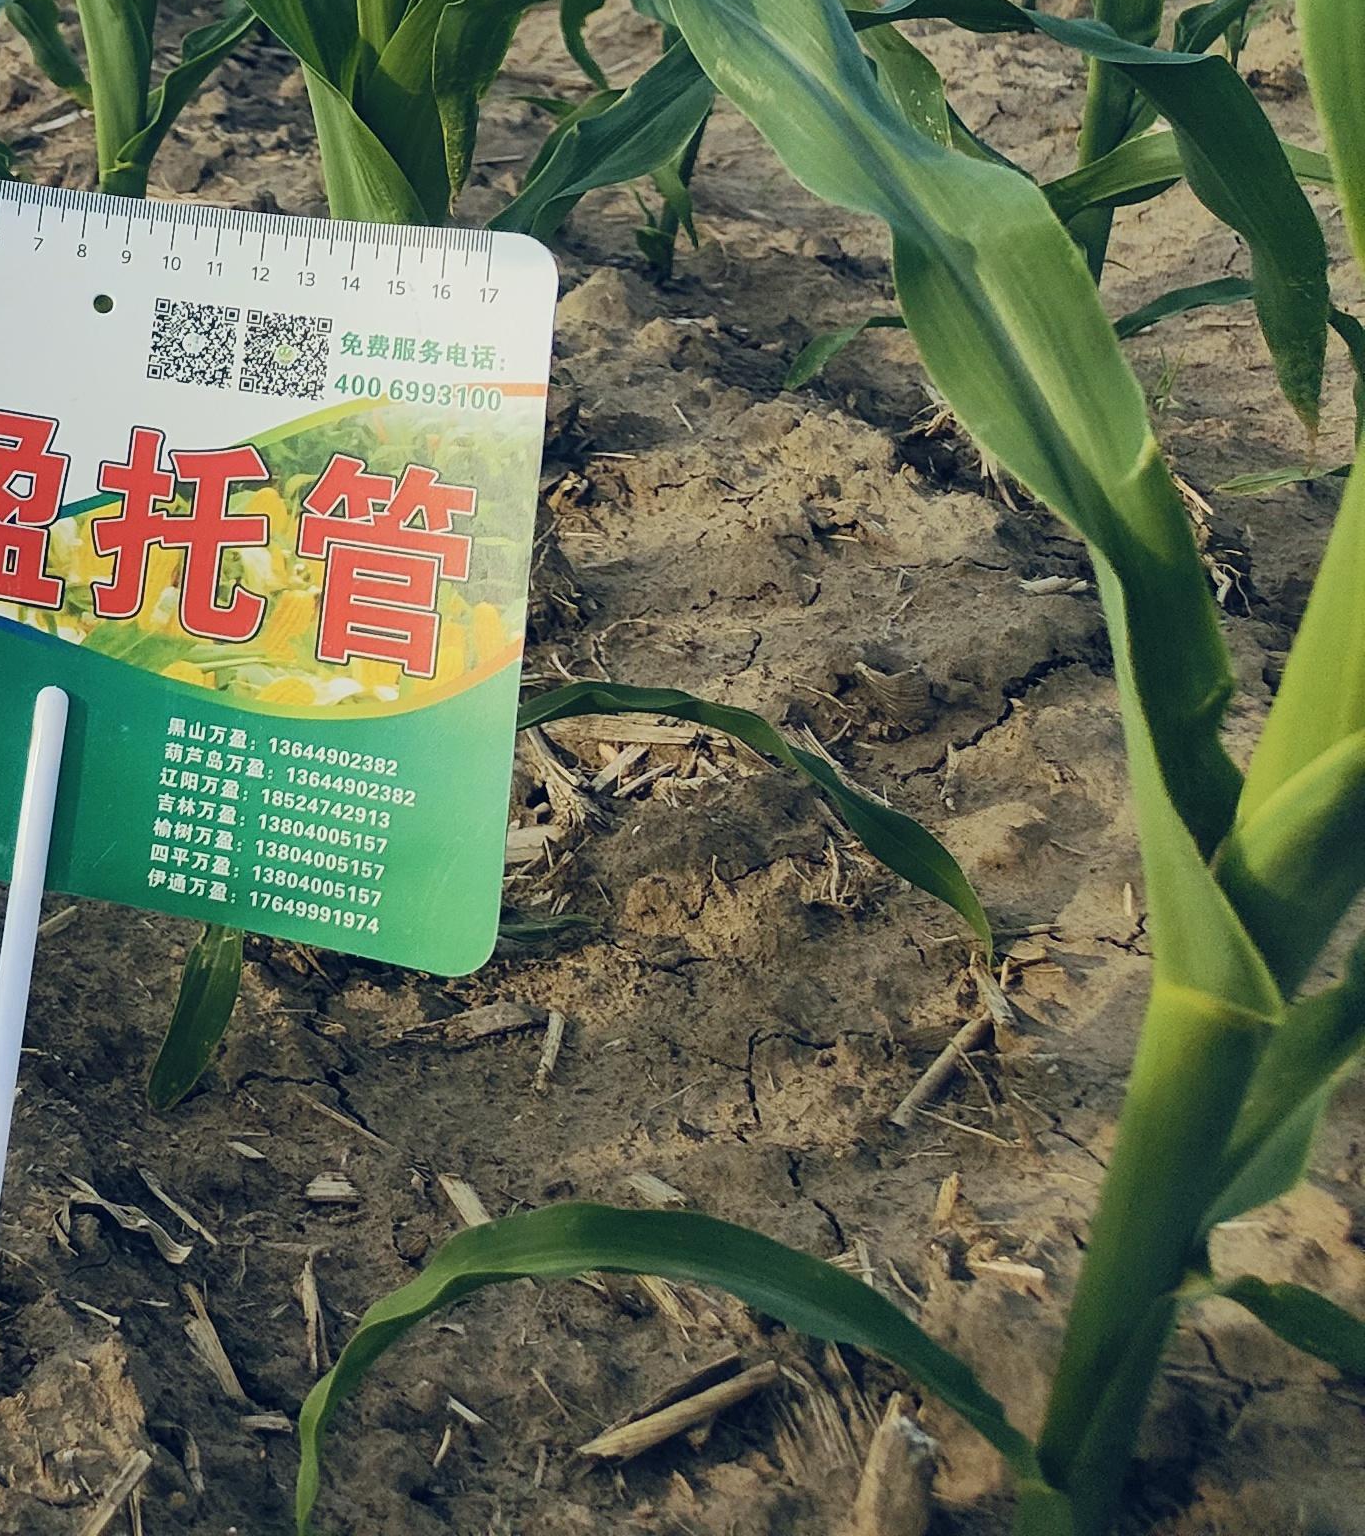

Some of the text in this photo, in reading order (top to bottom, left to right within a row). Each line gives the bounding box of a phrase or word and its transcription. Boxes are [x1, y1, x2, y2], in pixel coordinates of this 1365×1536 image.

[33, 237, 44, 251] 7
[77, 244, 87, 258] 8
[121, 250, 132, 264] 9
[162, 256, 181, 271] 10
[207, 262, 223, 276] 11
[252, 266, 270, 282] 12
[297, 272, 316, 287] 13
[342, 276, 361, 291] 14
[388, 280, 406, 296] 15
[432, 285, 451, 300] 16
[480, 288, 499, 304] 17
[334, 373, 502, 411] 400 6993100
[269, 737, 398, 777] 13644902382
[286, 767, 417, 807] 13644902382
[261, 788, 391, 829] 18524742913
[258, 814, 388, 854] 13804005157
[255, 839, 385, 880] 13804005157
[252, 865, 382, 907] 13804005157
[249, 891, 380, 934] 17649991974
